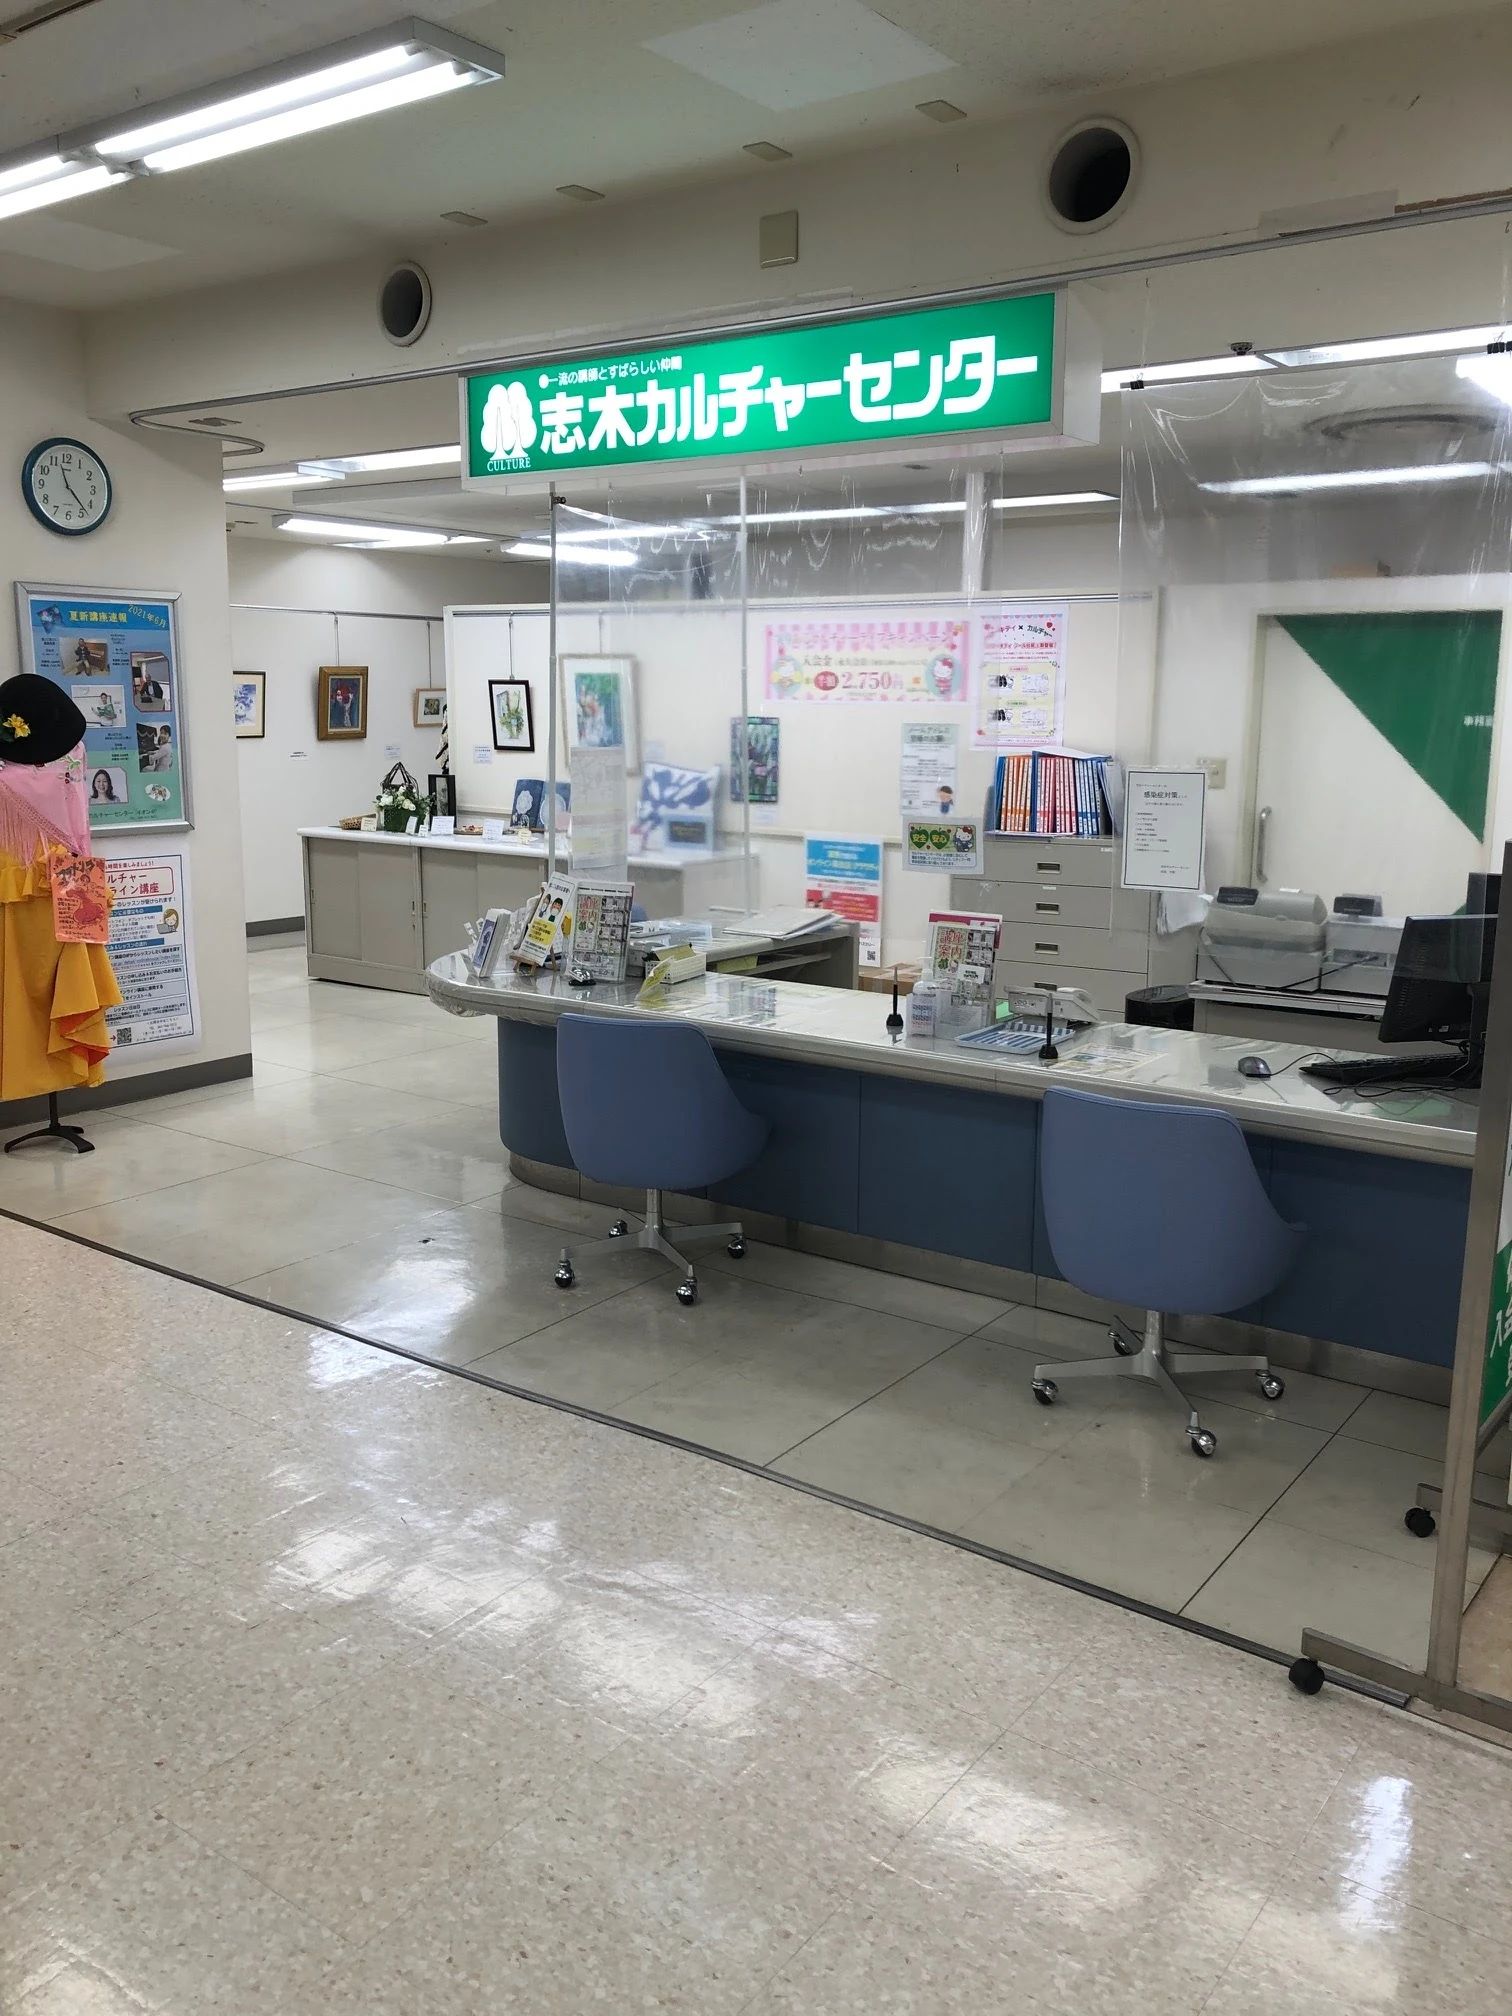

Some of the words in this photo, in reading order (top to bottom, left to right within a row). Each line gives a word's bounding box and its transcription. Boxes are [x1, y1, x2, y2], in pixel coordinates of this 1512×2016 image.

[539, 335, 1038, 455] 志木カルチャーセンター
[49, 455, 58, 466] 11
[61, 453, 72, 464] 12
[77, 459, 82, 469] 1
[486, 457, 532, 472] CULTURE
[39, 465, 50, 476] 10
[86, 470, 92, 481] 2
[38, 478, 45, 489] 9
[89, 485, 96, 496] 3
[42, 493, 49, 504] 8
[87, 499, 93, 509] 4
[53, 505, 60, 515] 7
[65, 510, 72, 521] 6
[77, 508, 84, 519] 5
[912, 833, 927, 843] 安全
[931, 834, 947, 843] 安心
